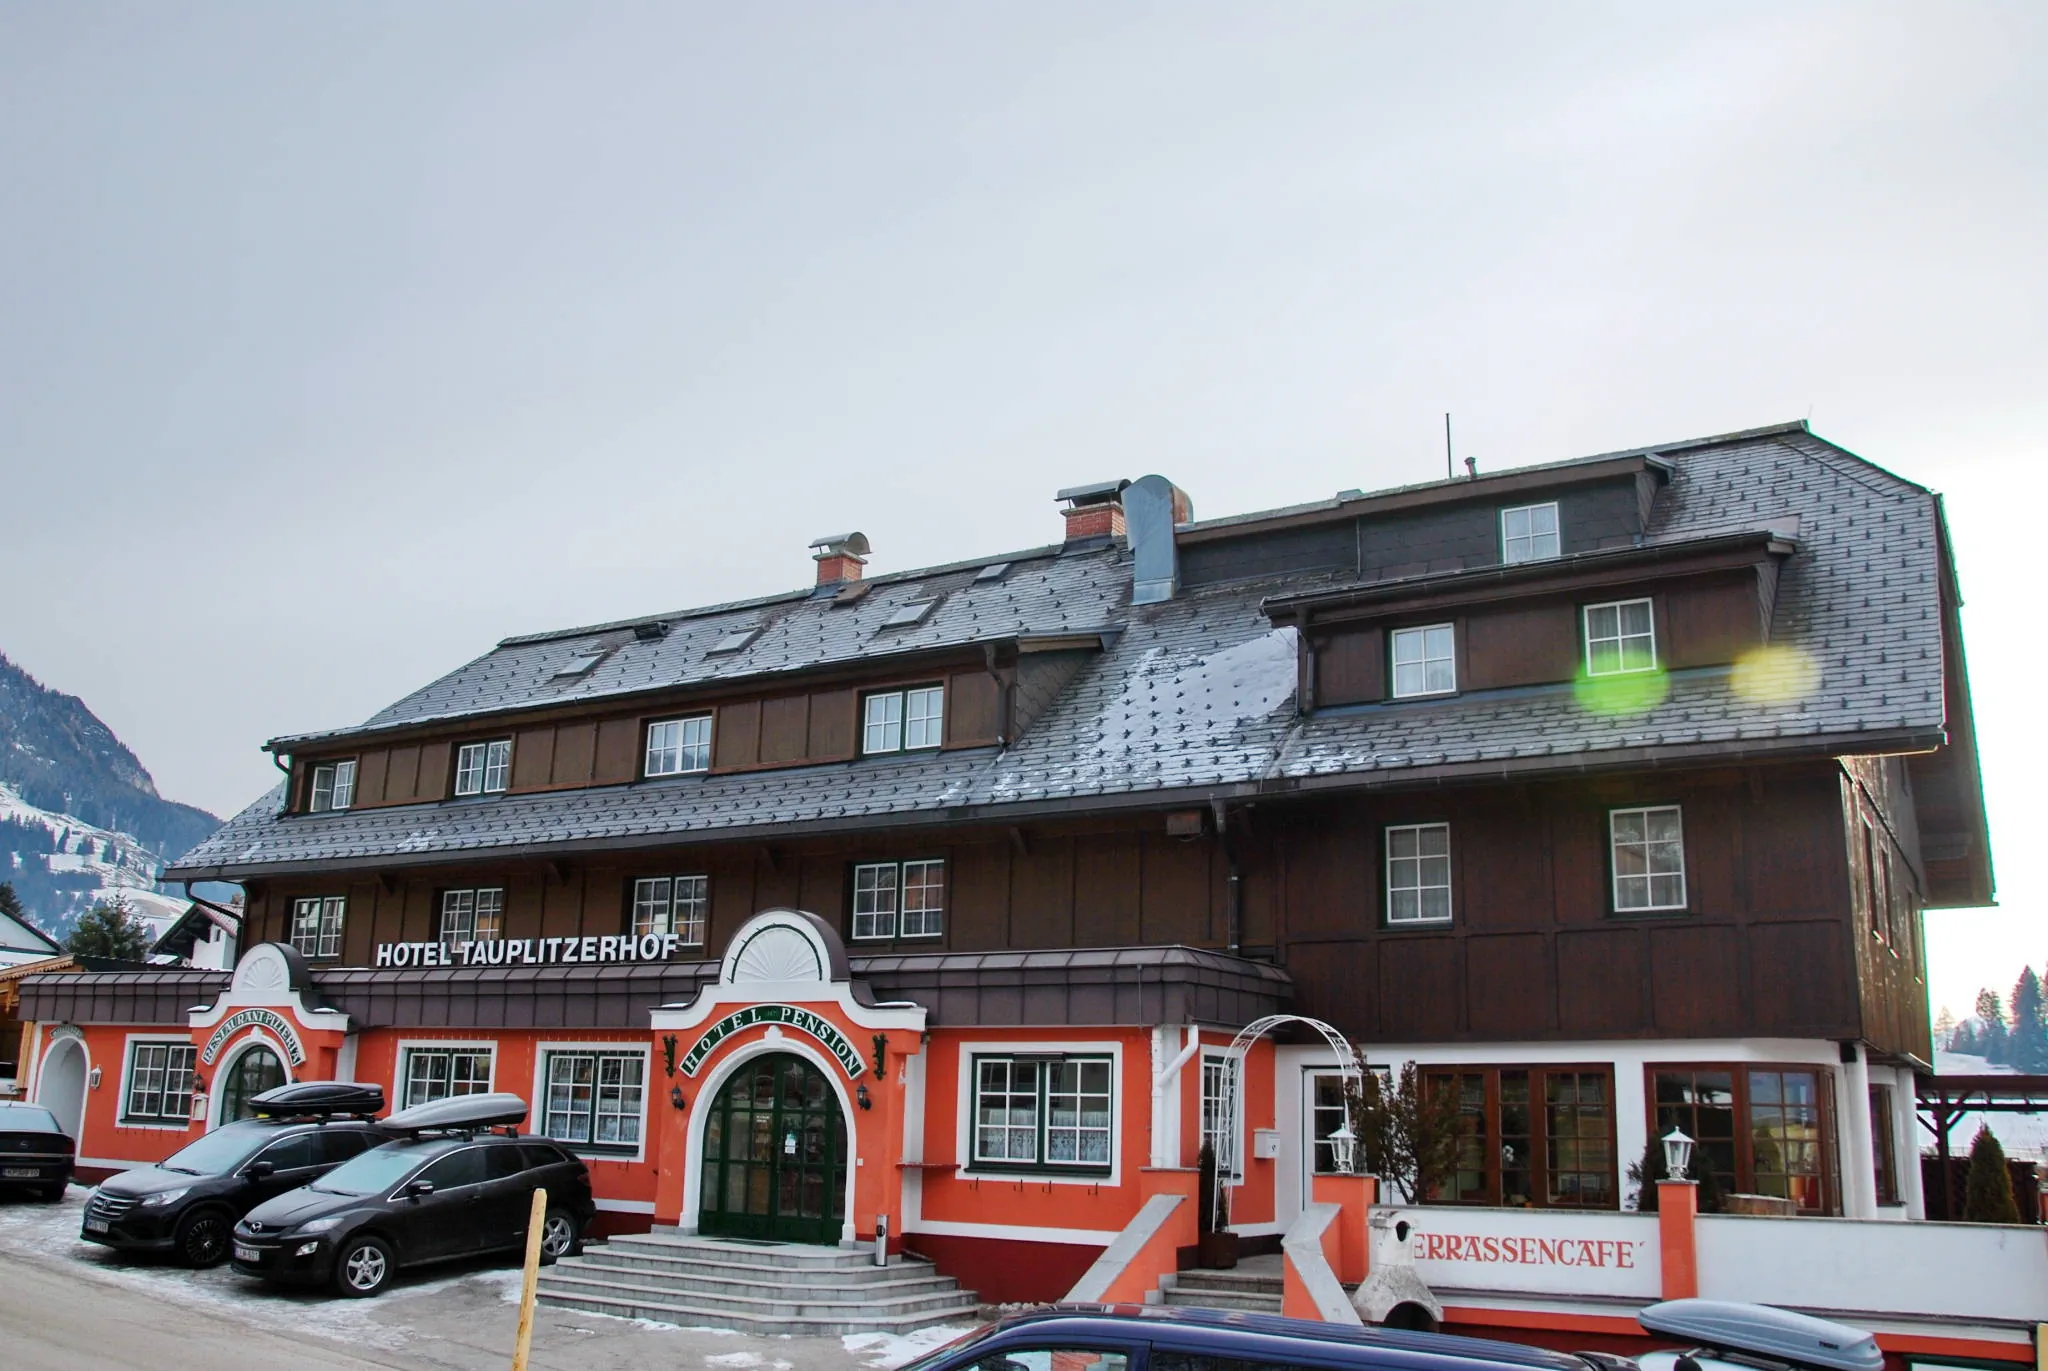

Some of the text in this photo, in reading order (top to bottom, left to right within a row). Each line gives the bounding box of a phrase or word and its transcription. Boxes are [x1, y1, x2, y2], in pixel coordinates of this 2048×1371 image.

[375, 933, 680, 967] HOTEL TAUPLITZERHOF
[685, 1007, 860, 1073] HOTEL PENSION
